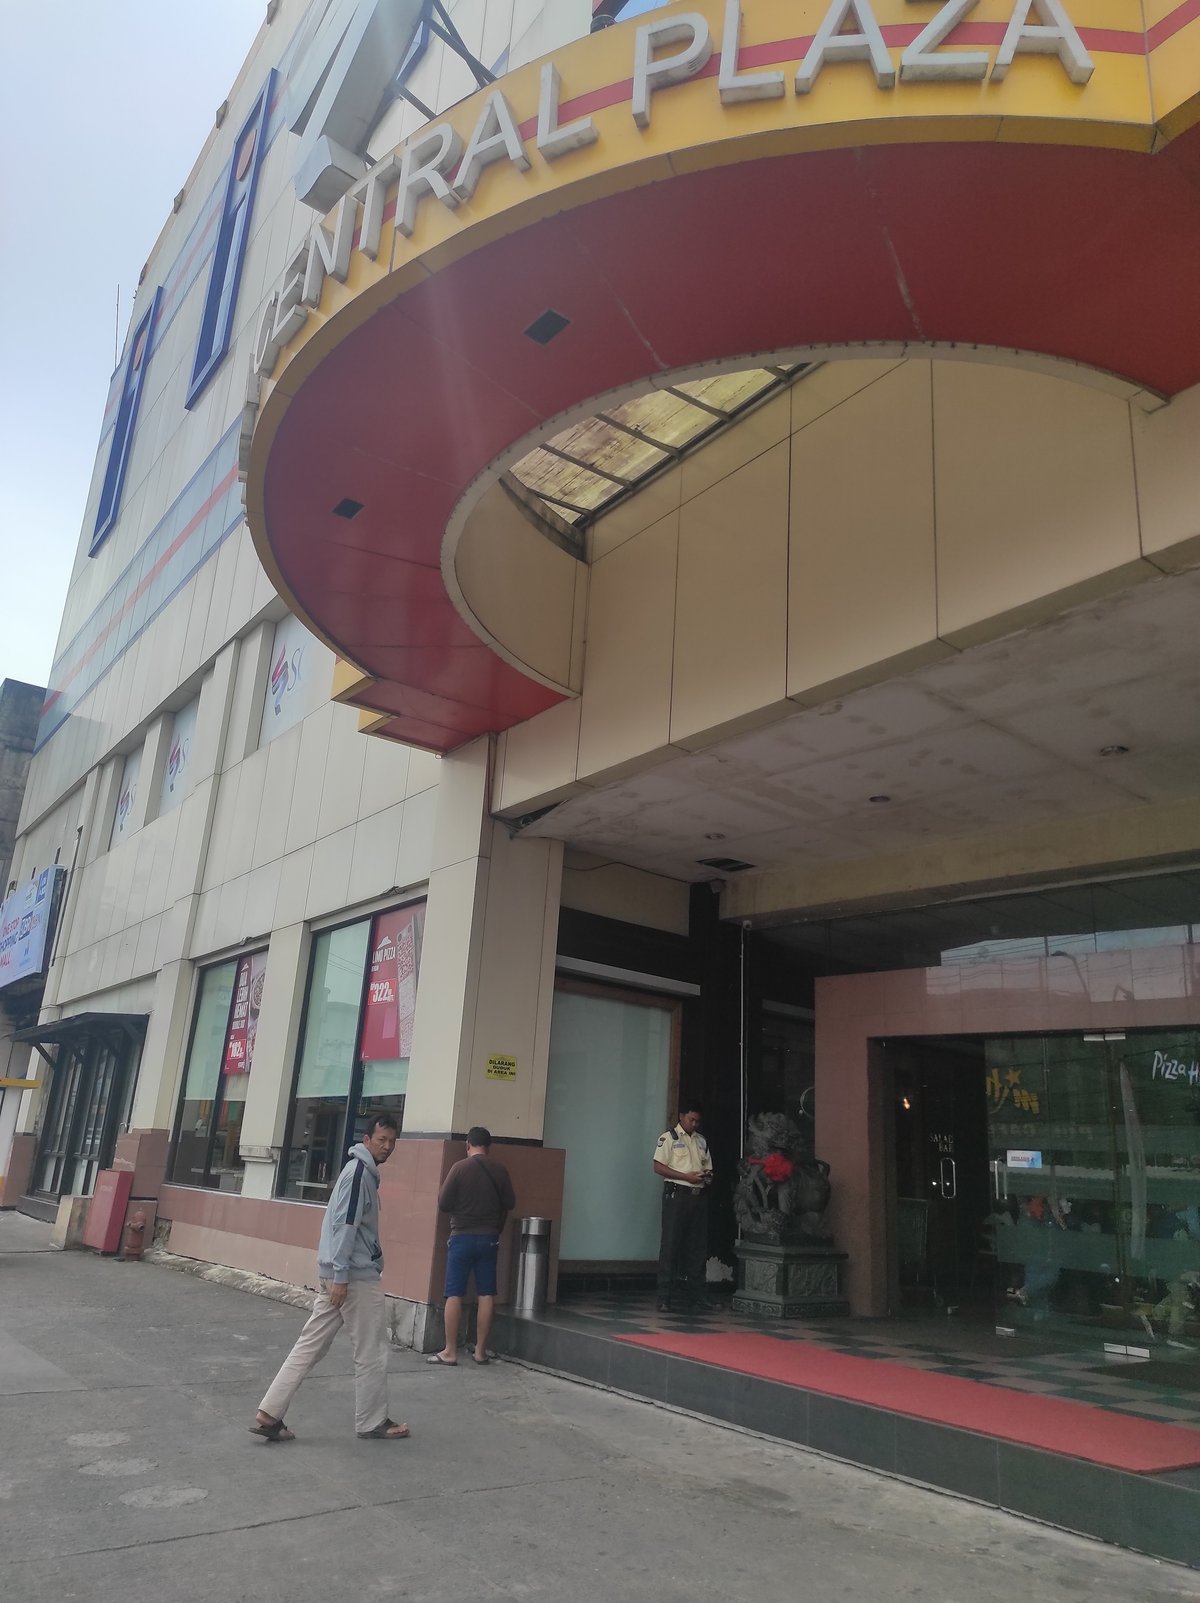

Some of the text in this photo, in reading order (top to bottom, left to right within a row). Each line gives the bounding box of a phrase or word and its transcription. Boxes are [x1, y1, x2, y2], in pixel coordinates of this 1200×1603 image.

[253, 0, 1096, 379] CENTRAL PLAZA
[384, 947, 396, 960] PIZZA
[1152, 1050, 1186, 1080] Pizza
